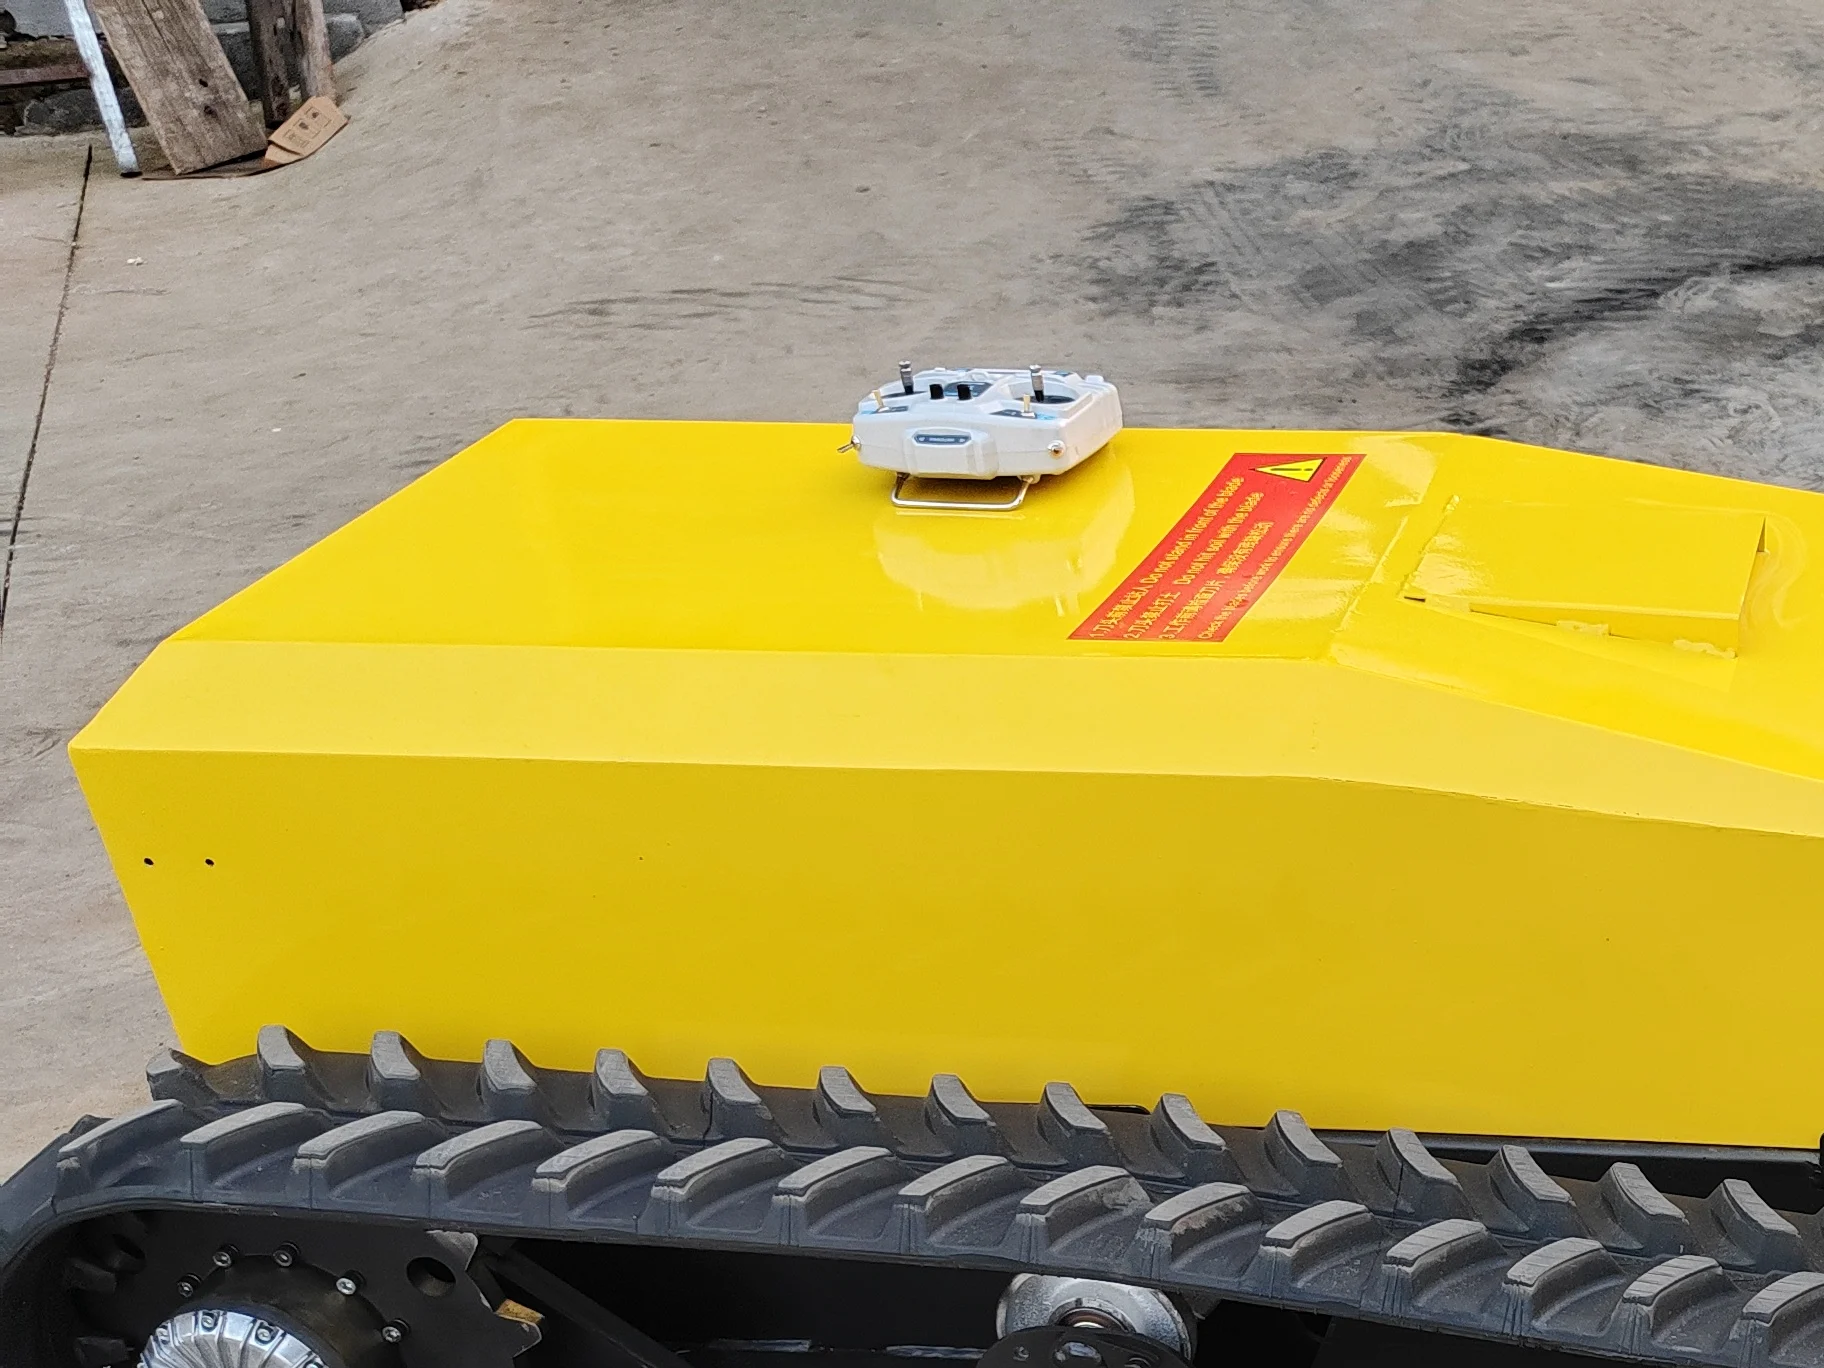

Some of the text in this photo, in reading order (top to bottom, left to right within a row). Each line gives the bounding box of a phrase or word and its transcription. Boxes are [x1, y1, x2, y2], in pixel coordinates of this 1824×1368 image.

[1217, 478, 1244, 496] blade
[1208, 498, 1228, 508] the
[1236, 493, 1264, 511] blade
[1228, 513, 1248, 523] the
[1185, 517, 1213, 533] front
[1217, 525, 1238, 538] with
[1166, 541, 1192, 560] stand
[1207, 539, 1226, 551] soil
[1194, 552, 1216, 561] hit
[1154, 561, 1175, 572] not
[1187, 562, 1207, 573] not
[1140, 573, 1162, 583] Do
[1173, 575, 1195, 584] Do
[1198, 621, 1223, 638] Check
